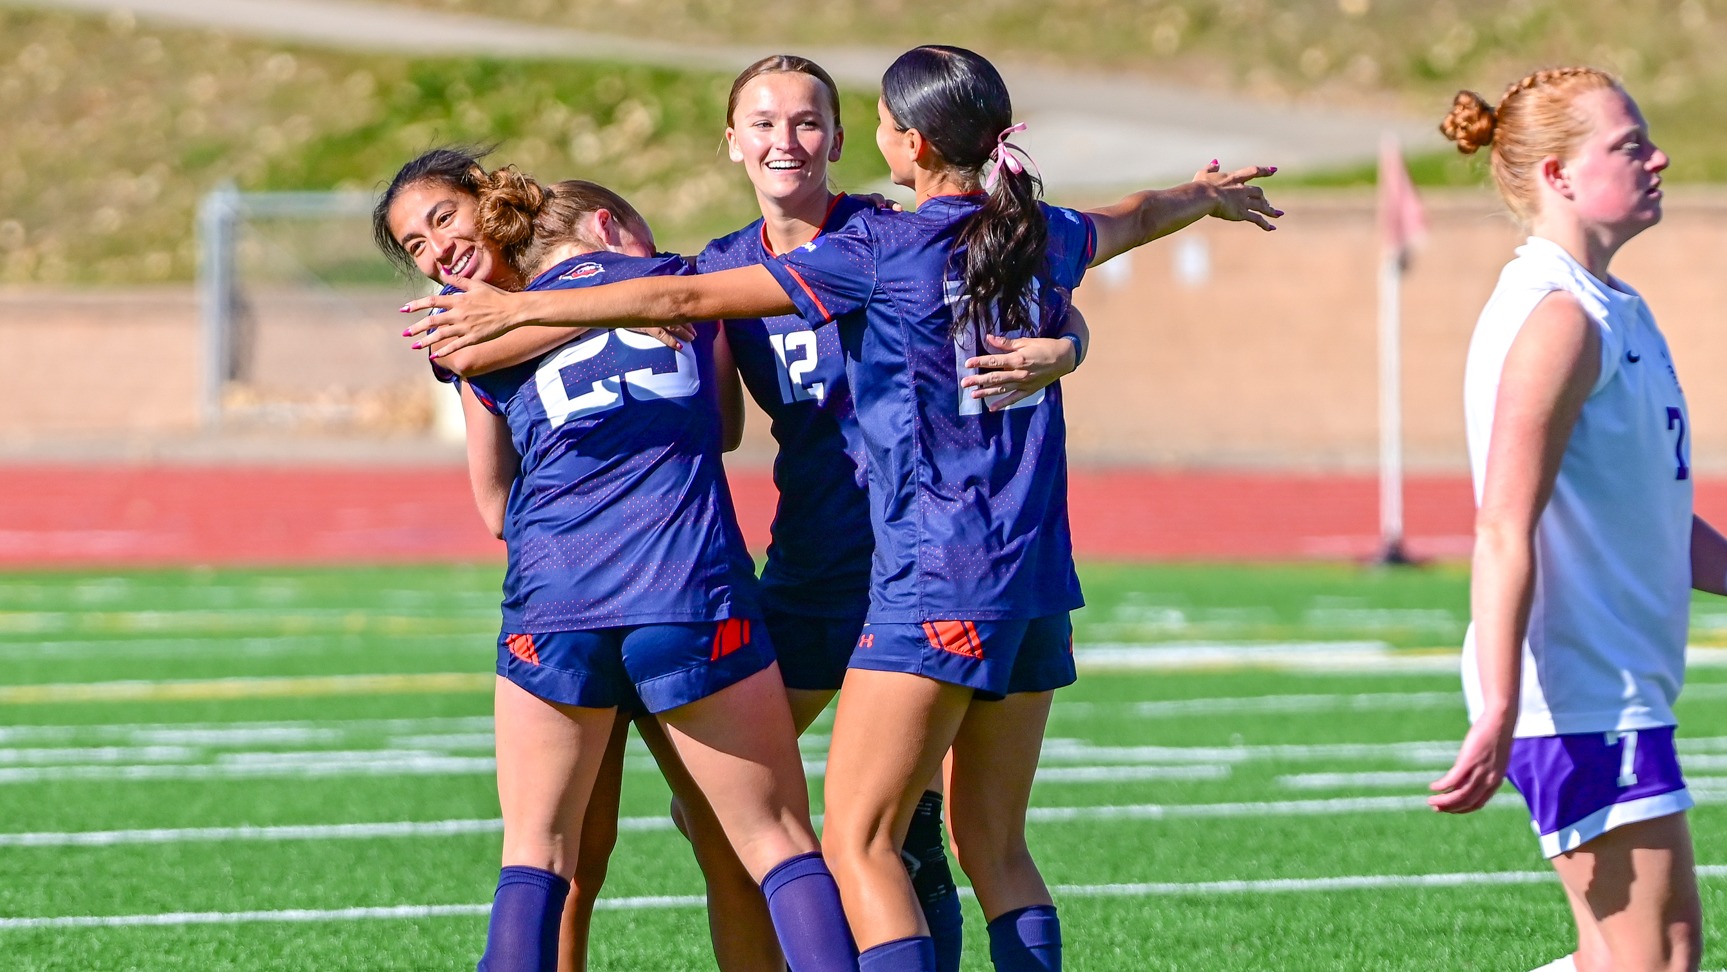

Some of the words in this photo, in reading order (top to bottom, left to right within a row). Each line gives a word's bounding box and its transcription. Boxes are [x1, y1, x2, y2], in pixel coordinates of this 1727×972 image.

[769, 330, 825, 404] 12
[1666, 406, 1689, 480] 7
[1604, 731, 1639, 788] 7
